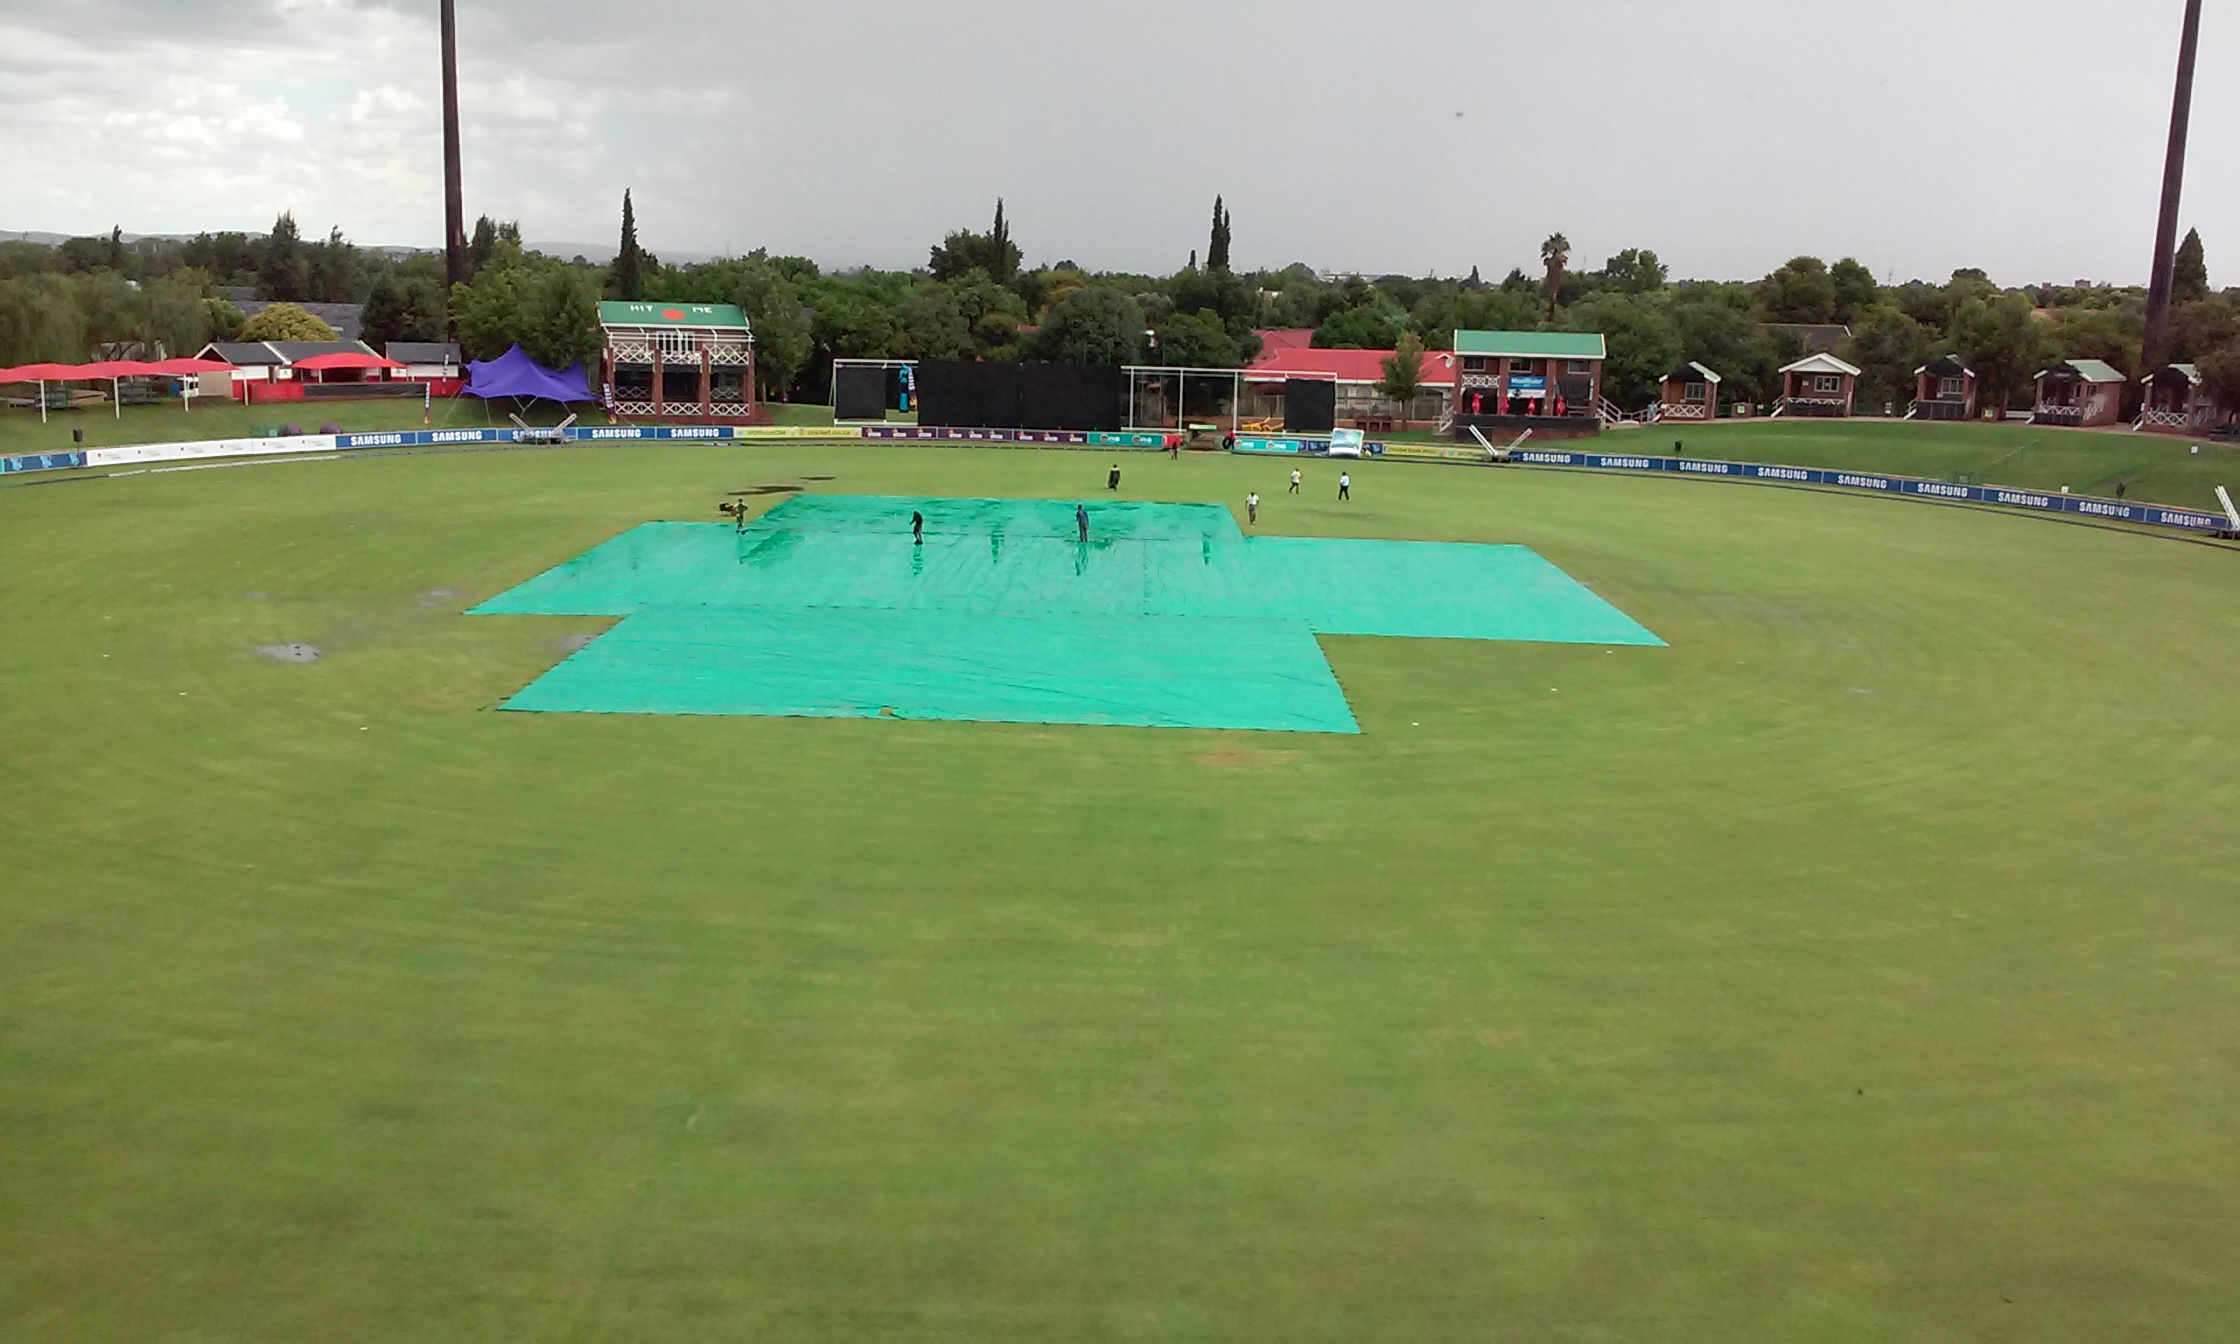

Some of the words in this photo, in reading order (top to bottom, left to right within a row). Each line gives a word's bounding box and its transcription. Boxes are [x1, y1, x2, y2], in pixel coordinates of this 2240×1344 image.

[629, 304, 653, 313] HIT
[692, 306, 713, 314] ME
[350, 433, 402, 446] SAMSUNG
[432, 430, 482, 442] SAMSUNG
[592, 428, 641, 439] SAMSUNG
[670, 428, 720, 438] SAMSUNG
[1522, 452, 1571, 463] SAMSUNG
[1600, 457, 1649, 468] SAMSUNG
[1679, 461, 1728, 474] SAMSUNG
[1758, 467, 1808, 480] SAMSUNG
[1837, 474, 1887, 489] SAMSUNG
[1917, 483, 1968, 498] SAMSUNG
[1998, 492, 2048, 507] SAMSUNG
[2079, 501, 2130, 517] SAMSUNG
[2160, 512, 2211, 526] SAMSUNG
